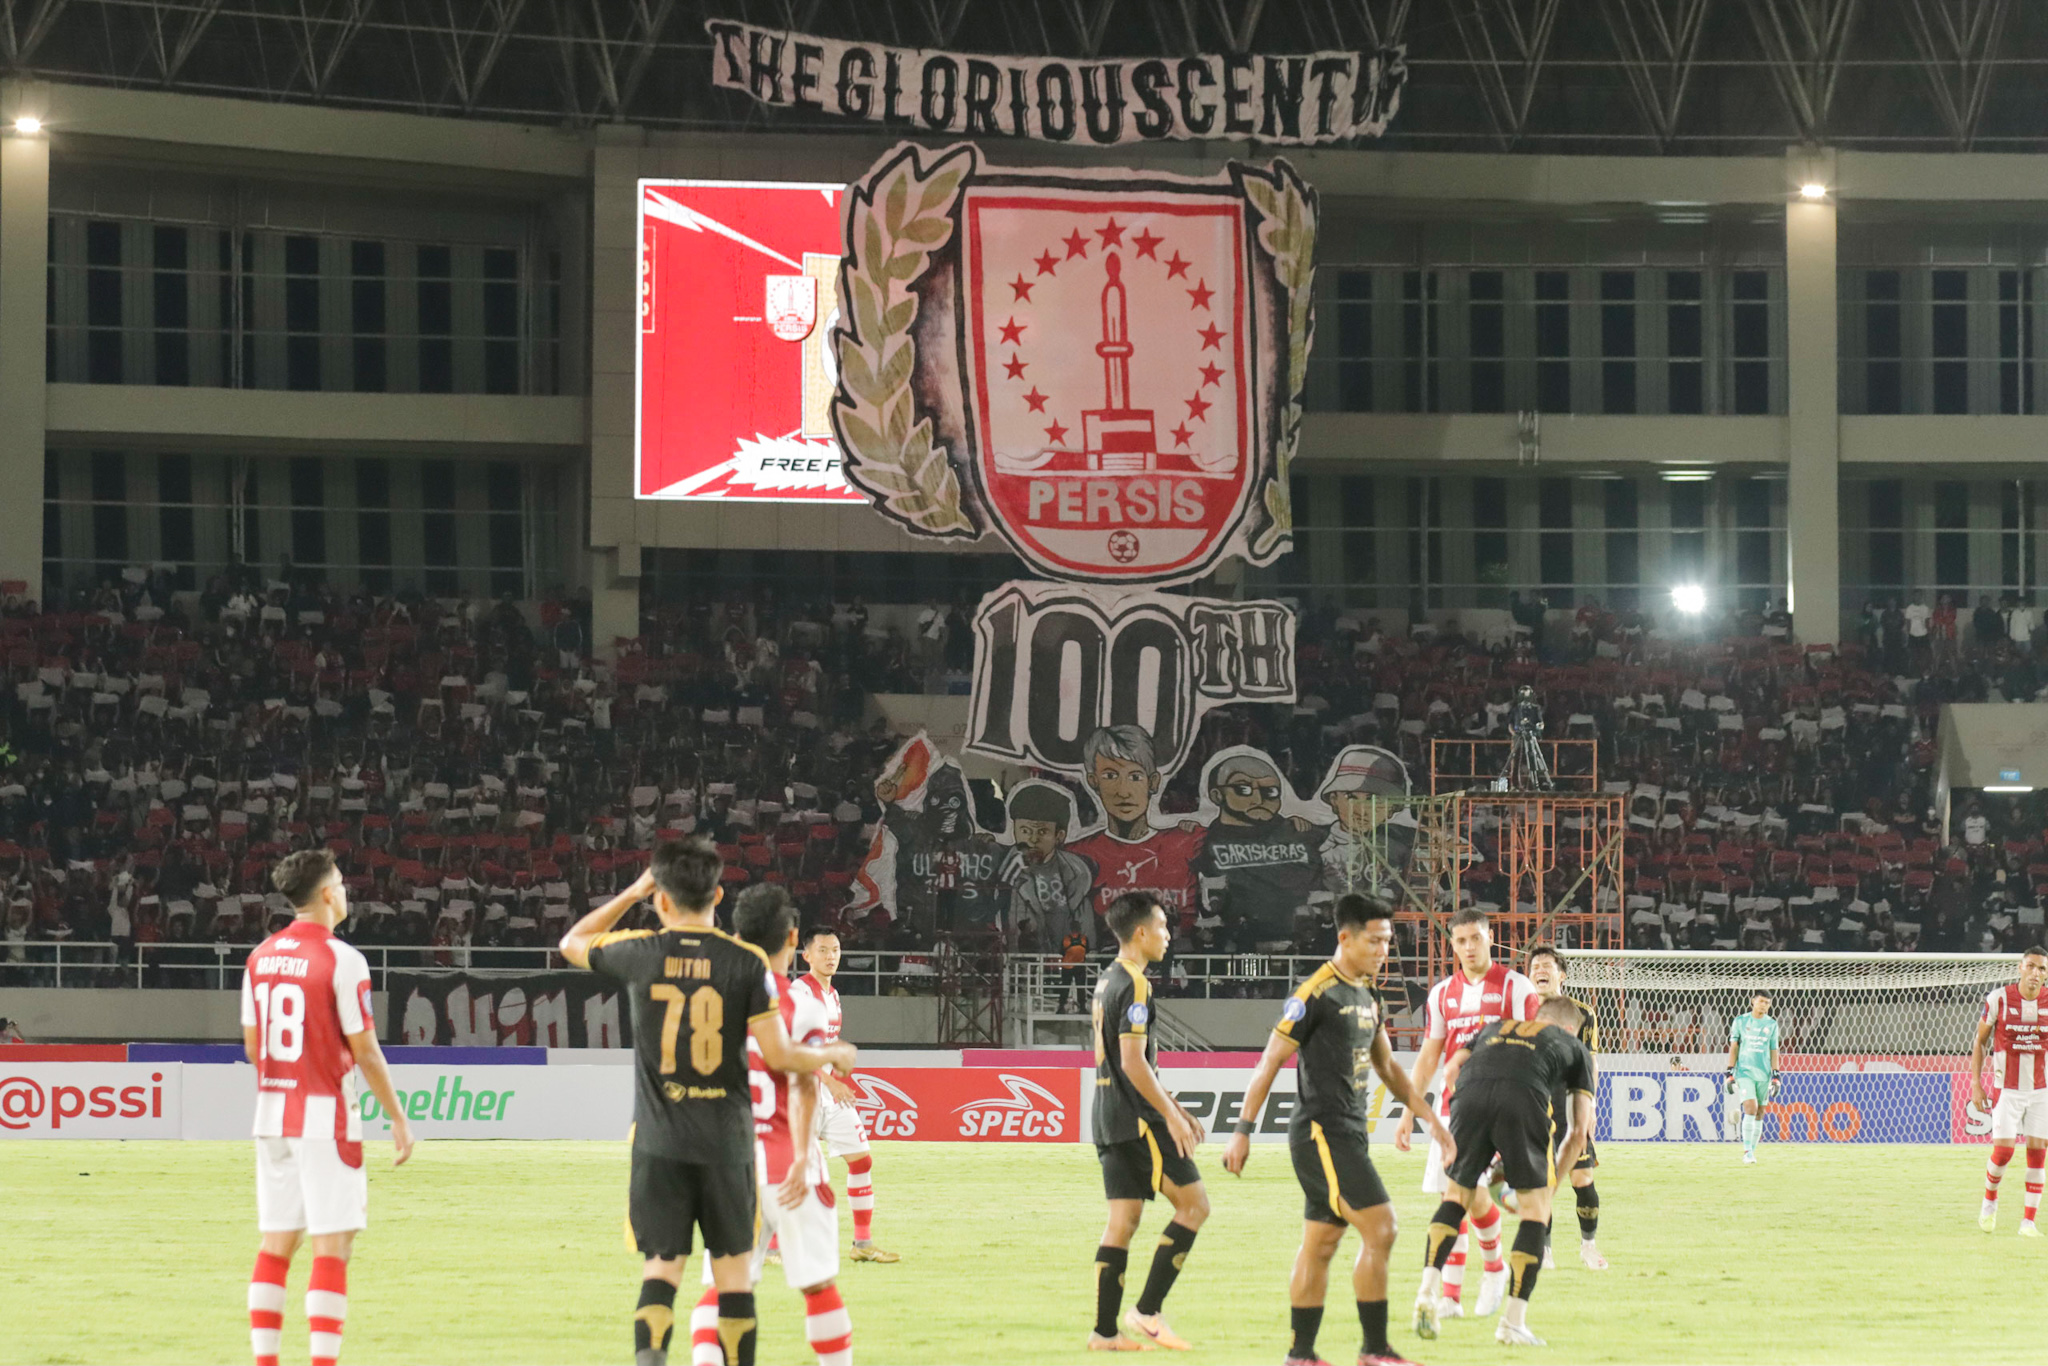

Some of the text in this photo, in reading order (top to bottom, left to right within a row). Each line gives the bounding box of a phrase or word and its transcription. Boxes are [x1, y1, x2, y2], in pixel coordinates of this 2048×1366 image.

[710, 22, 825, 110] THE
[760, 458, 822, 472] FREE
[1028, 479, 1205, 523] PERSIS
[255, 956, 309, 978] ARAPENTA
[664, 956, 711, 979] WITAN
[254, 982, 305, 1063] 18
[651, 984, 724, 1076] 78
[0, 1072, 163, 1130] @pssi
[958, 1110, 1066, 1137] SPECS
